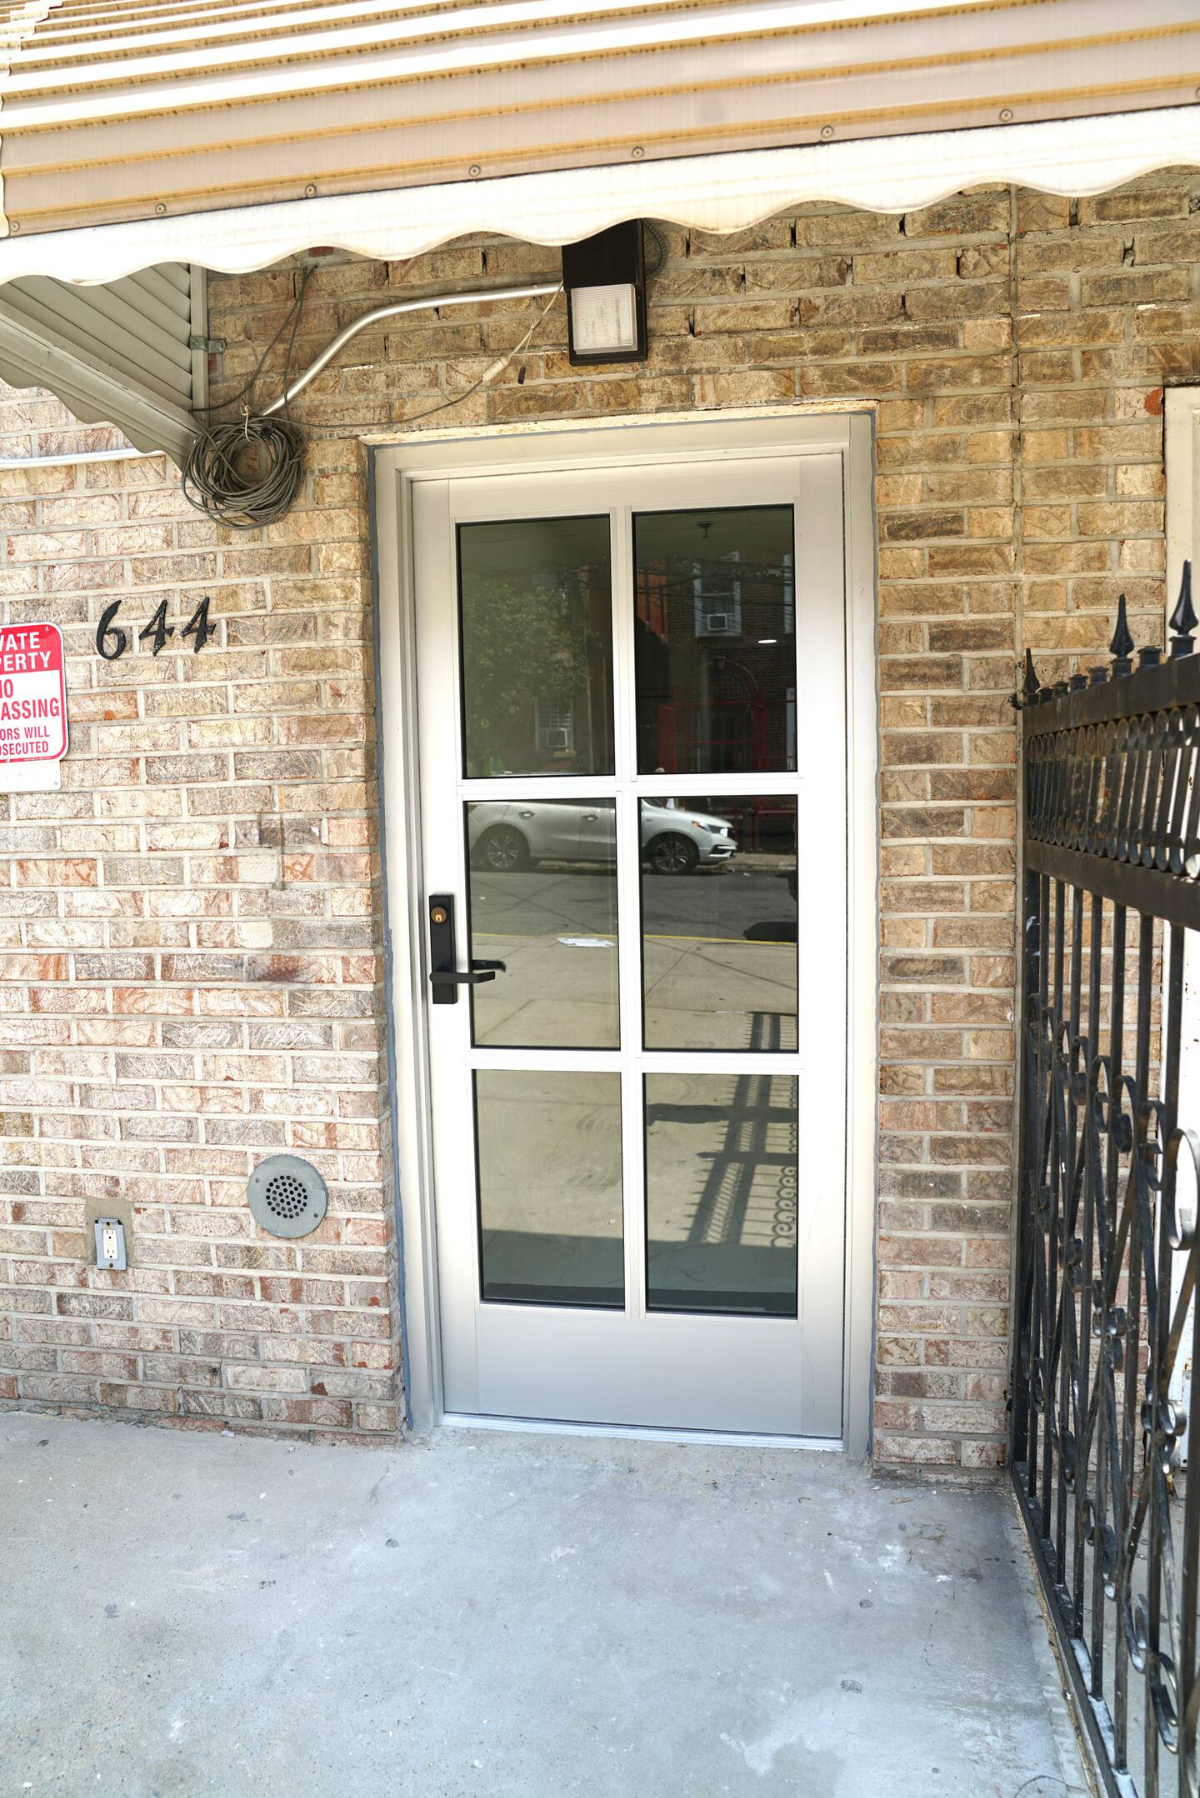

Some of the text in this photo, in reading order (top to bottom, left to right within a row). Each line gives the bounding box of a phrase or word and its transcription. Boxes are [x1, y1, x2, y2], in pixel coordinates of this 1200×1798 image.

[96, 596, 217, 660] 644
[0, 651, 51, 672] ERTY
[1, 697, 60, 721] ASSING
[24, 725, 50, 739] WILL
[0, 741, 49, 756] SECUTED
